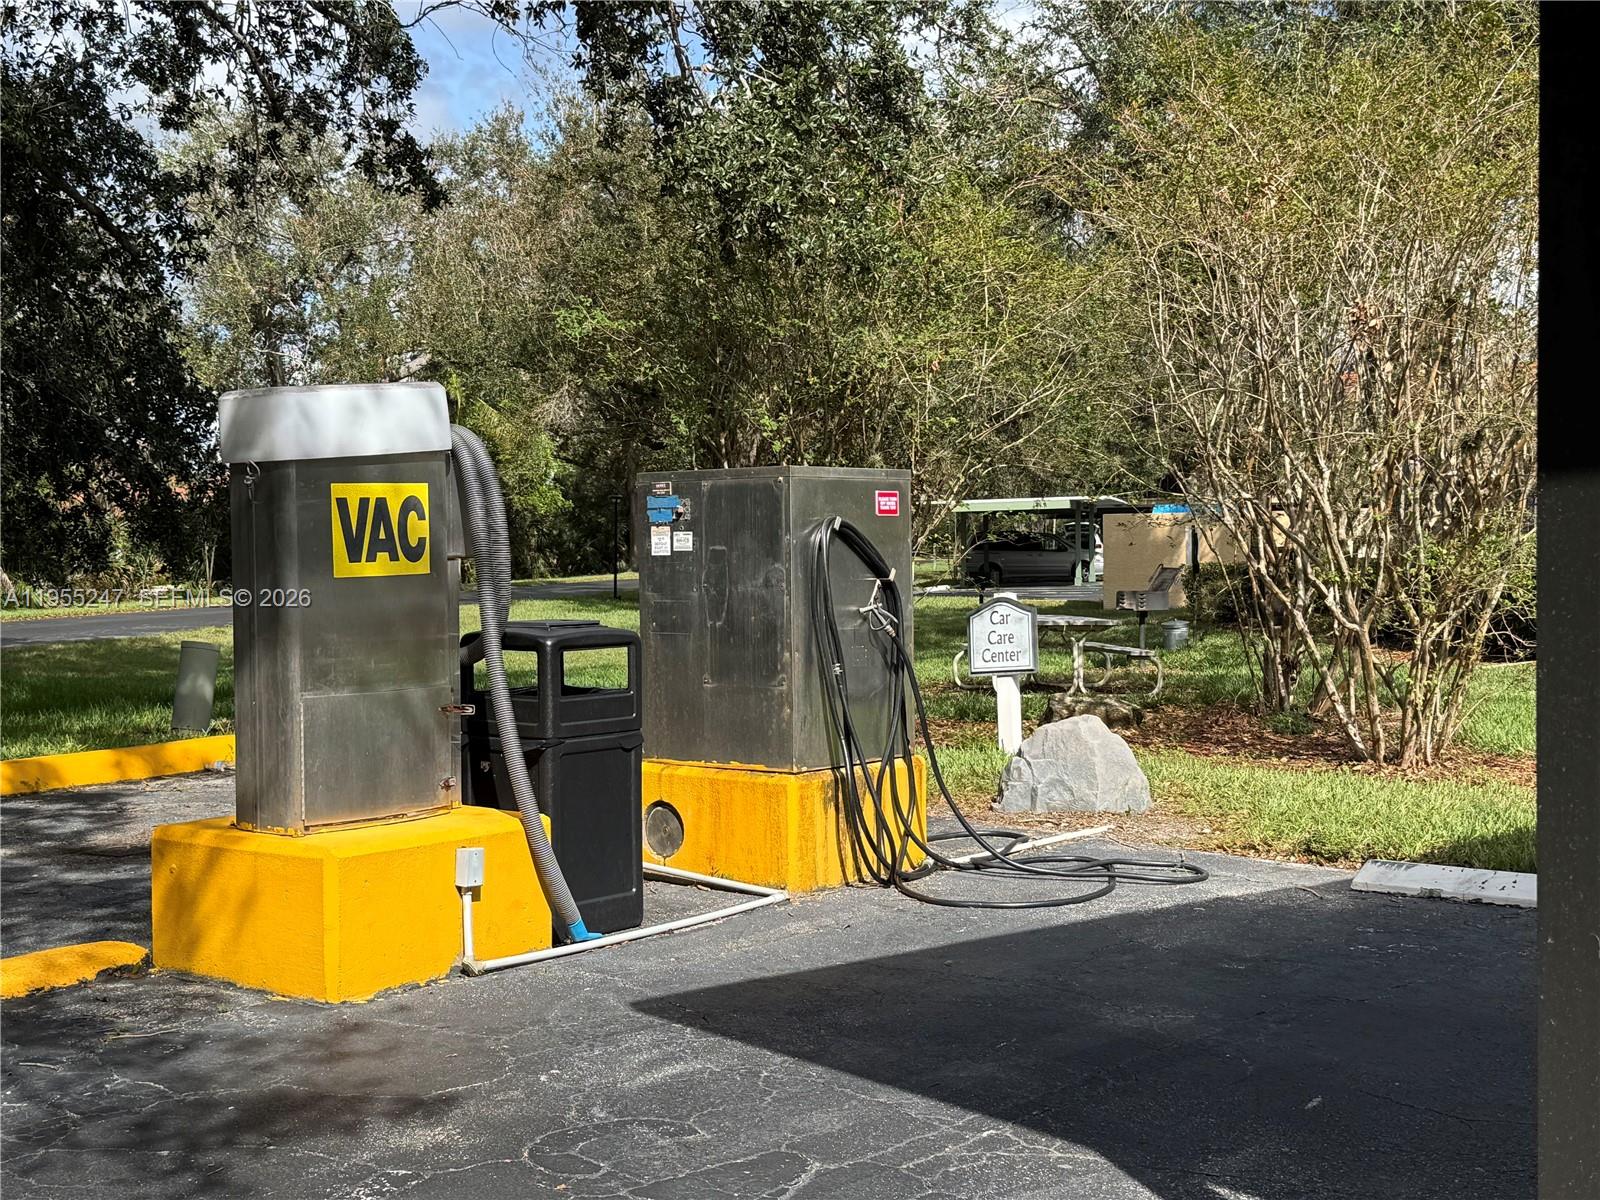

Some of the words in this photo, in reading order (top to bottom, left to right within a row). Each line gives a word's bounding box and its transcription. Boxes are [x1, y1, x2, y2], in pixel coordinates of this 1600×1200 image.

[336, 495, 427, 563] VAC
[989, 610, 1011, 625] Car
[987, 630, 1015, 645] Care
[981, 648, 1022, 663] Center
